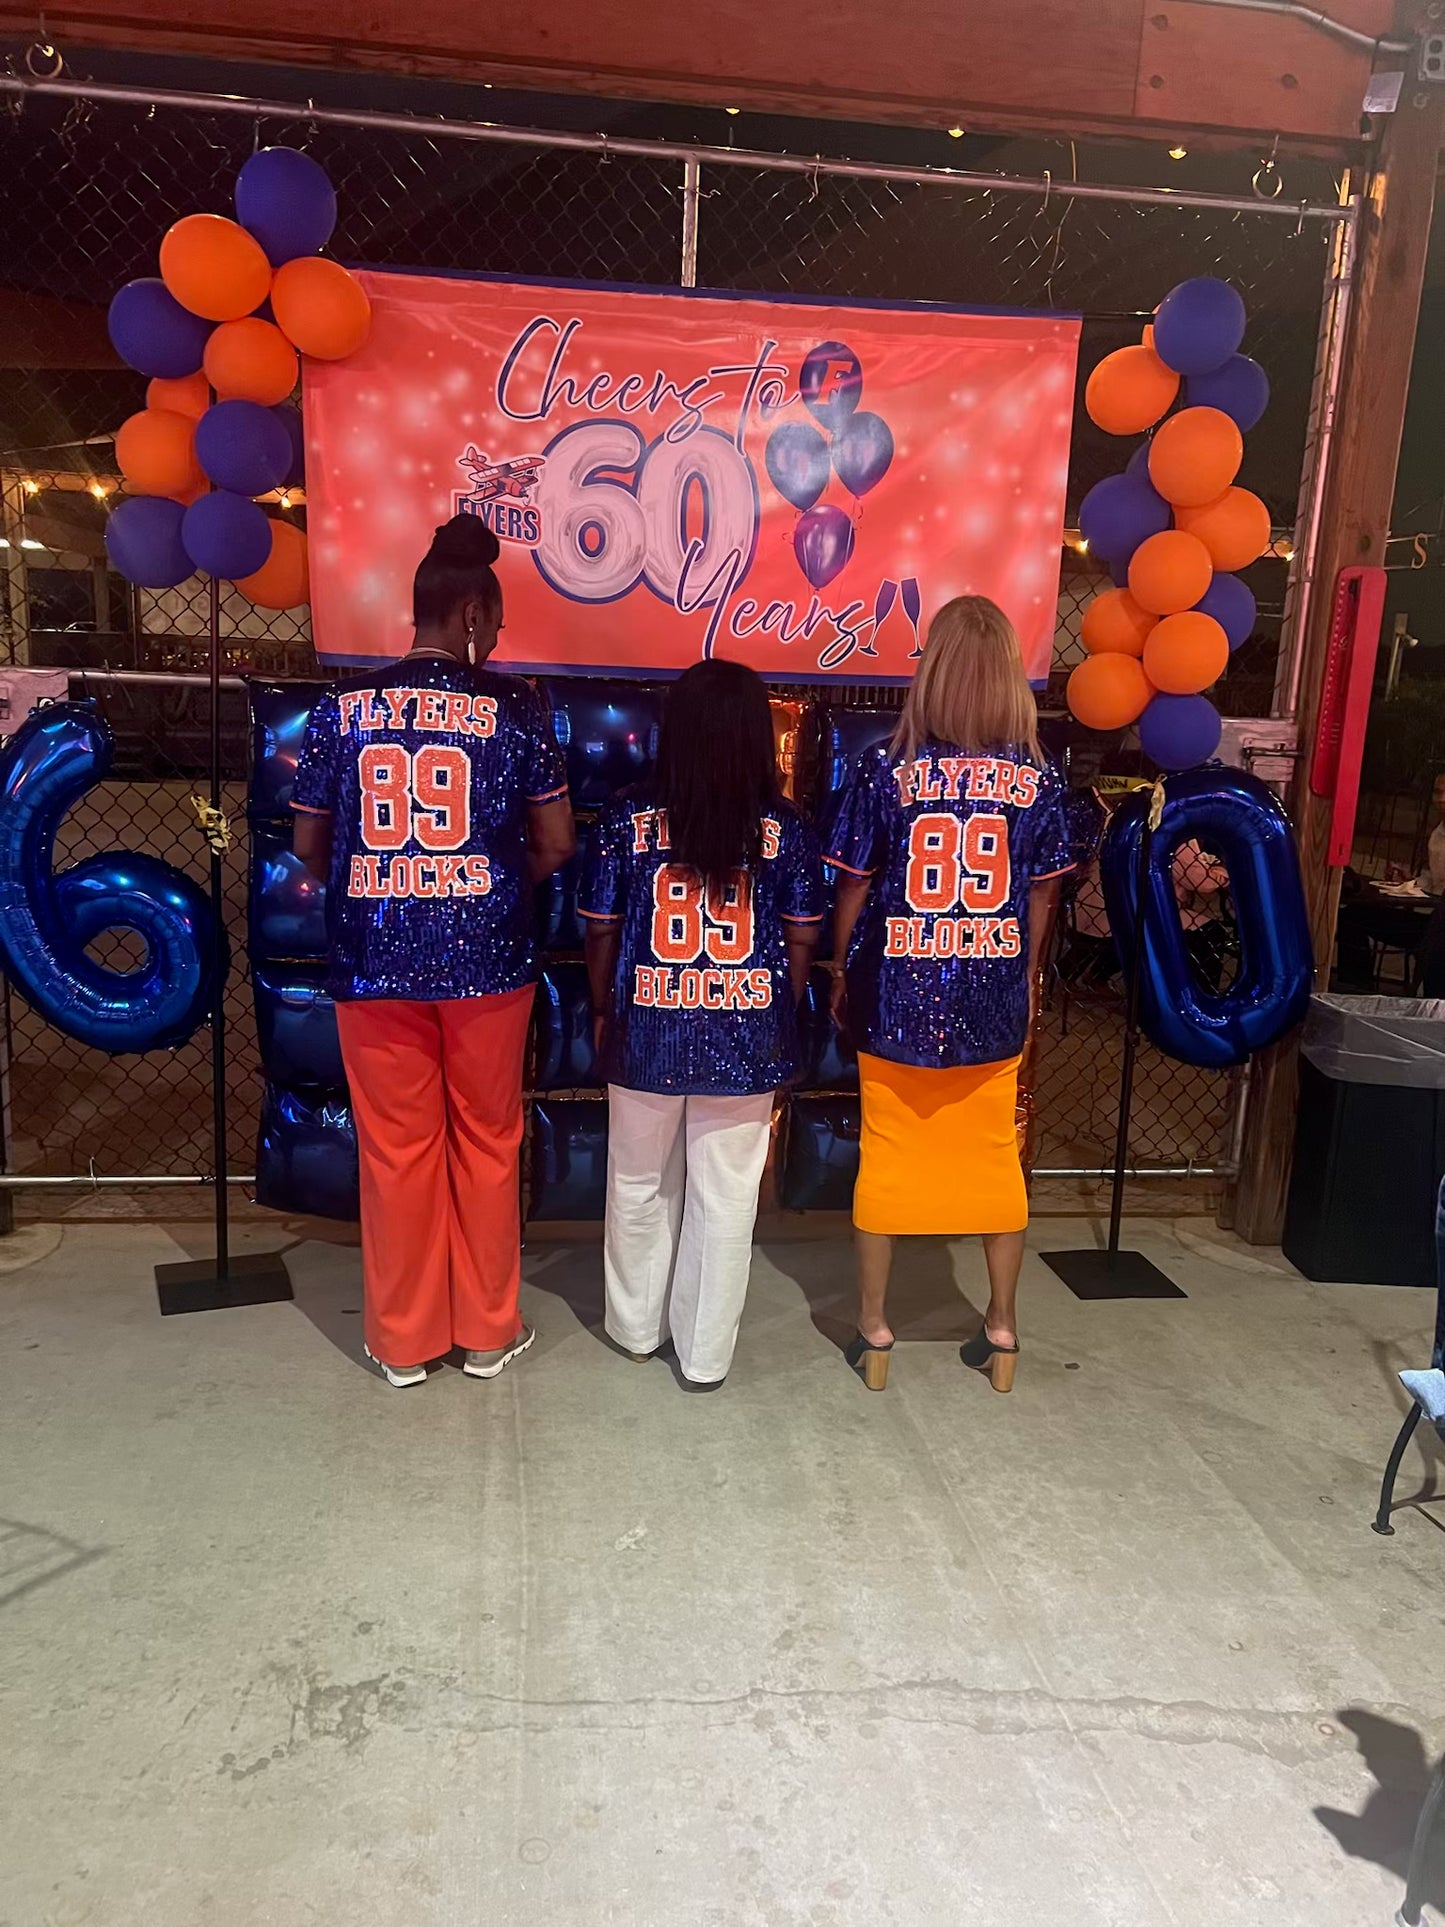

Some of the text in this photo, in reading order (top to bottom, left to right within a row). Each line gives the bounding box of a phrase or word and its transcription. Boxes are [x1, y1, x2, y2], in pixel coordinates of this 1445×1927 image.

[498, 316, 800, 456] Cheers to
[813, 360, 853, 406] F
[530, 418, 760, 606] 60
[673, 538, 875, 669] Years
[338, 688, 498, 738] FLYERS
[358, 743, 471, 851] 89
[893, 757, 1039, 808] FLYERS
[348, 855, 491, 898] BLOCKS
[905, 813, 1011, 913] 89
[651, 862, 755, 965] 89
[884, 917, 1021, 958] BLOCKS
[633, 965, 772, 1009] BLOCKS
